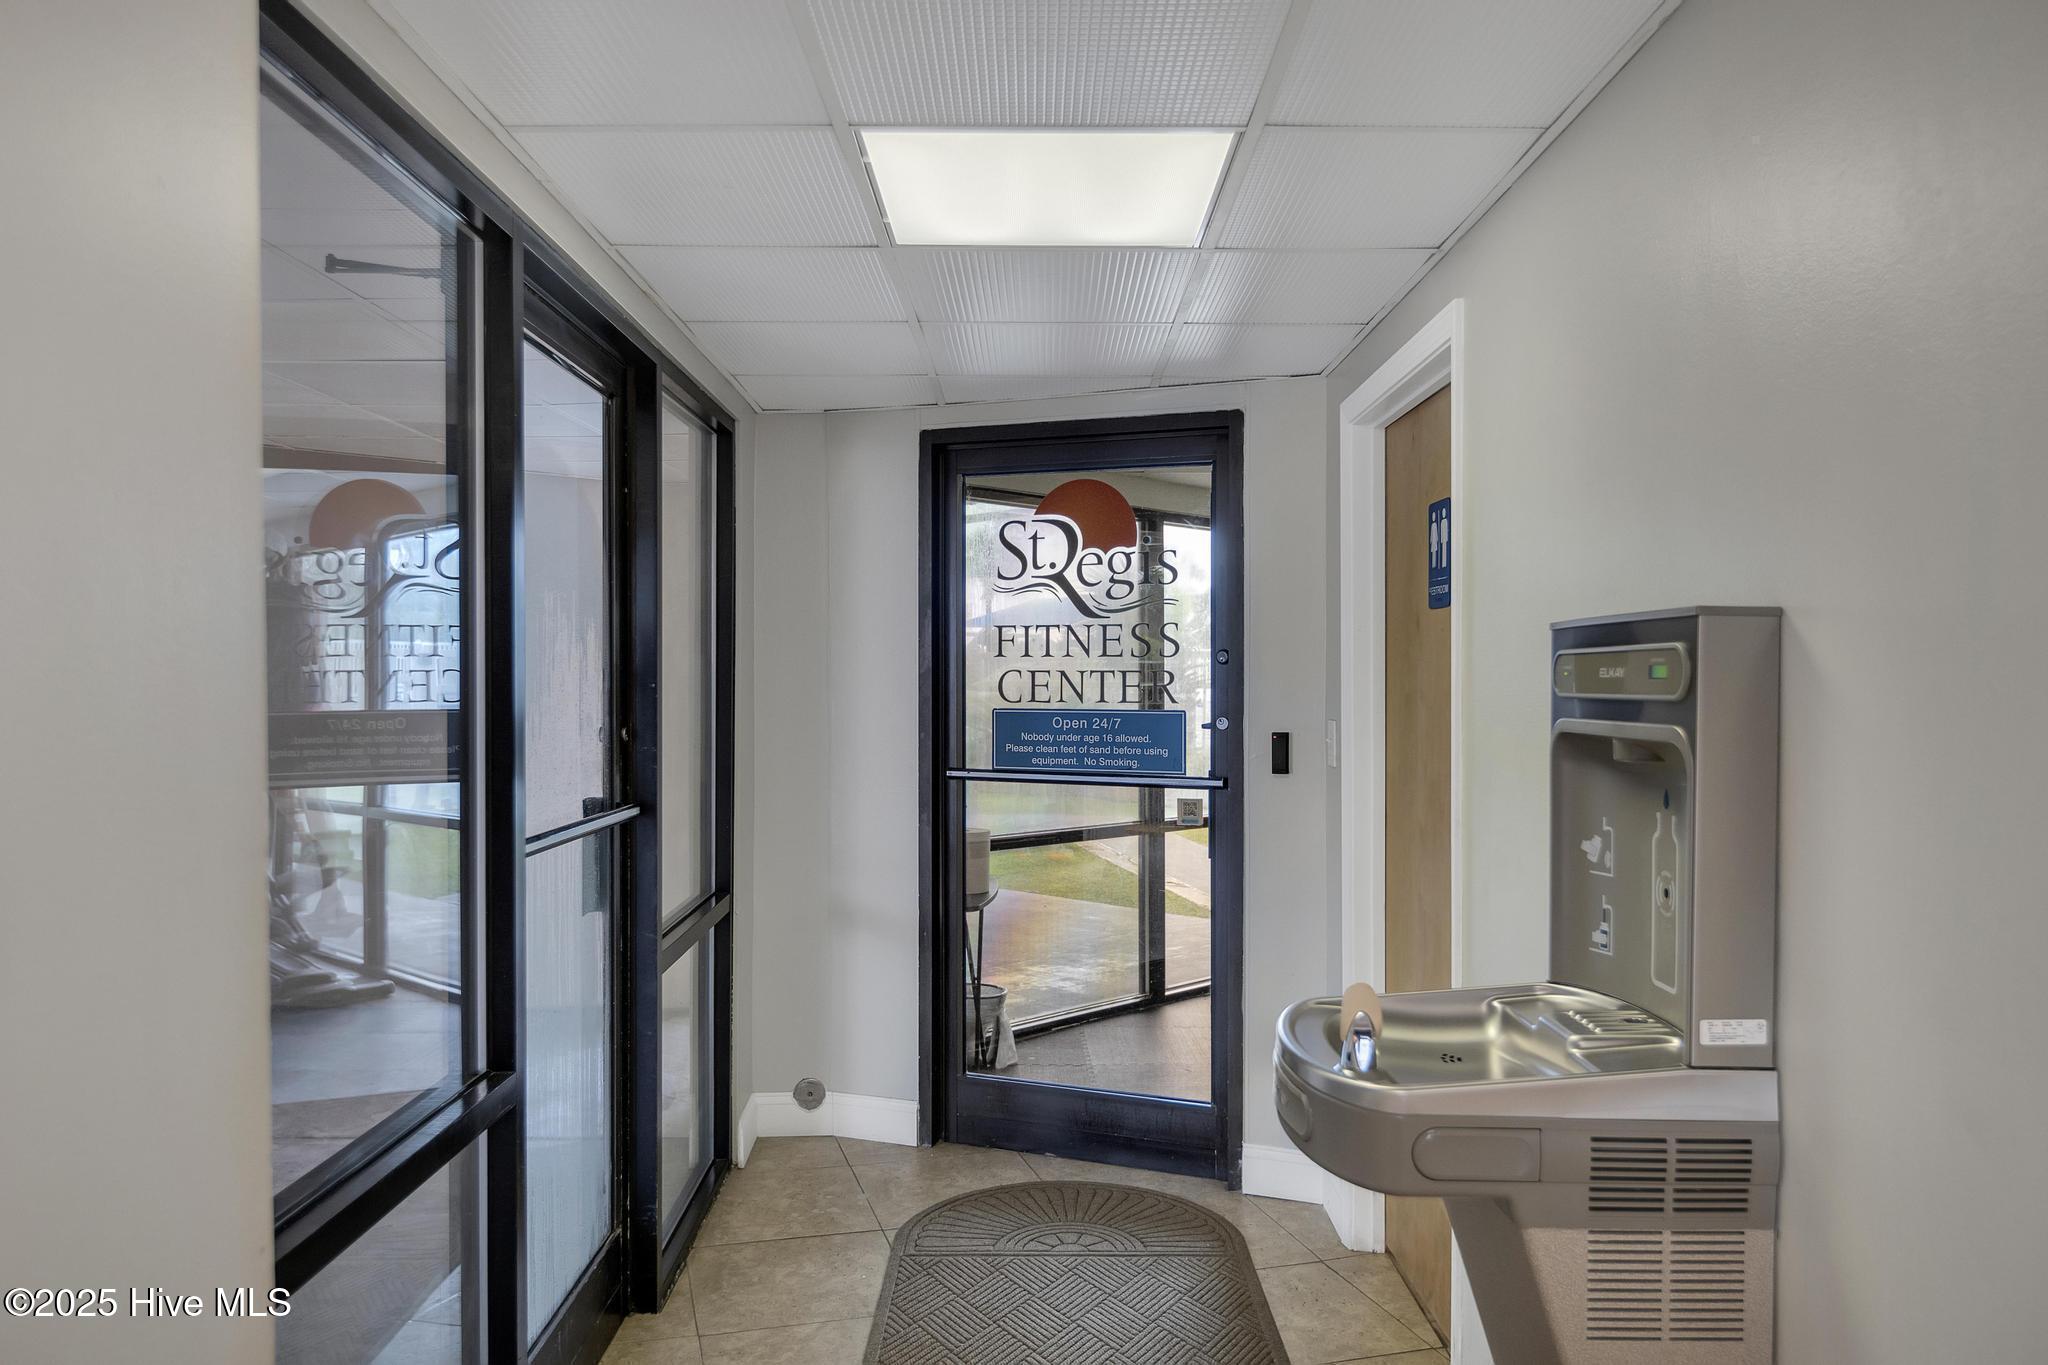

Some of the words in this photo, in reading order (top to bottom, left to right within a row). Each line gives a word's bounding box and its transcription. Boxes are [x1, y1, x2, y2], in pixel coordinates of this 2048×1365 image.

[997, 520, 1057, 581] St.
[1031, 519, 1179, 618] Regis
[993, 622, 1181, 658] FITNESS
[1599, 667, 1625, 678] ELKAY
[997, 669, 1180, 705] CENTER
[1052, 716, 1088, 731] Open
[1092, 717, 1122, 730] 24/7
[1021, 732, 1054, 744] Nobody
[1056, 733, 1081, 742] under
[1083, 735, 1100, 744] age
[1102, 734, 1113, 743] 16
[1115, 734, 1152, 744] allowed.
[1005, 743, 1034, 753] Please
[1035, 744, 1059, 753] clean
[1060, 745, 1077, 754] feet
[1078, 745, 1088, 754] of
[1089, 746, 1111, 755] sand
[1113, 746, 1142, 755] before
[1143, 747, 1169, 758] using
[1031, 756, 1079, 767] equipment.
[1084, 757, 1097, 766] No
[1098, 757, 1140, 768] Smoking.
